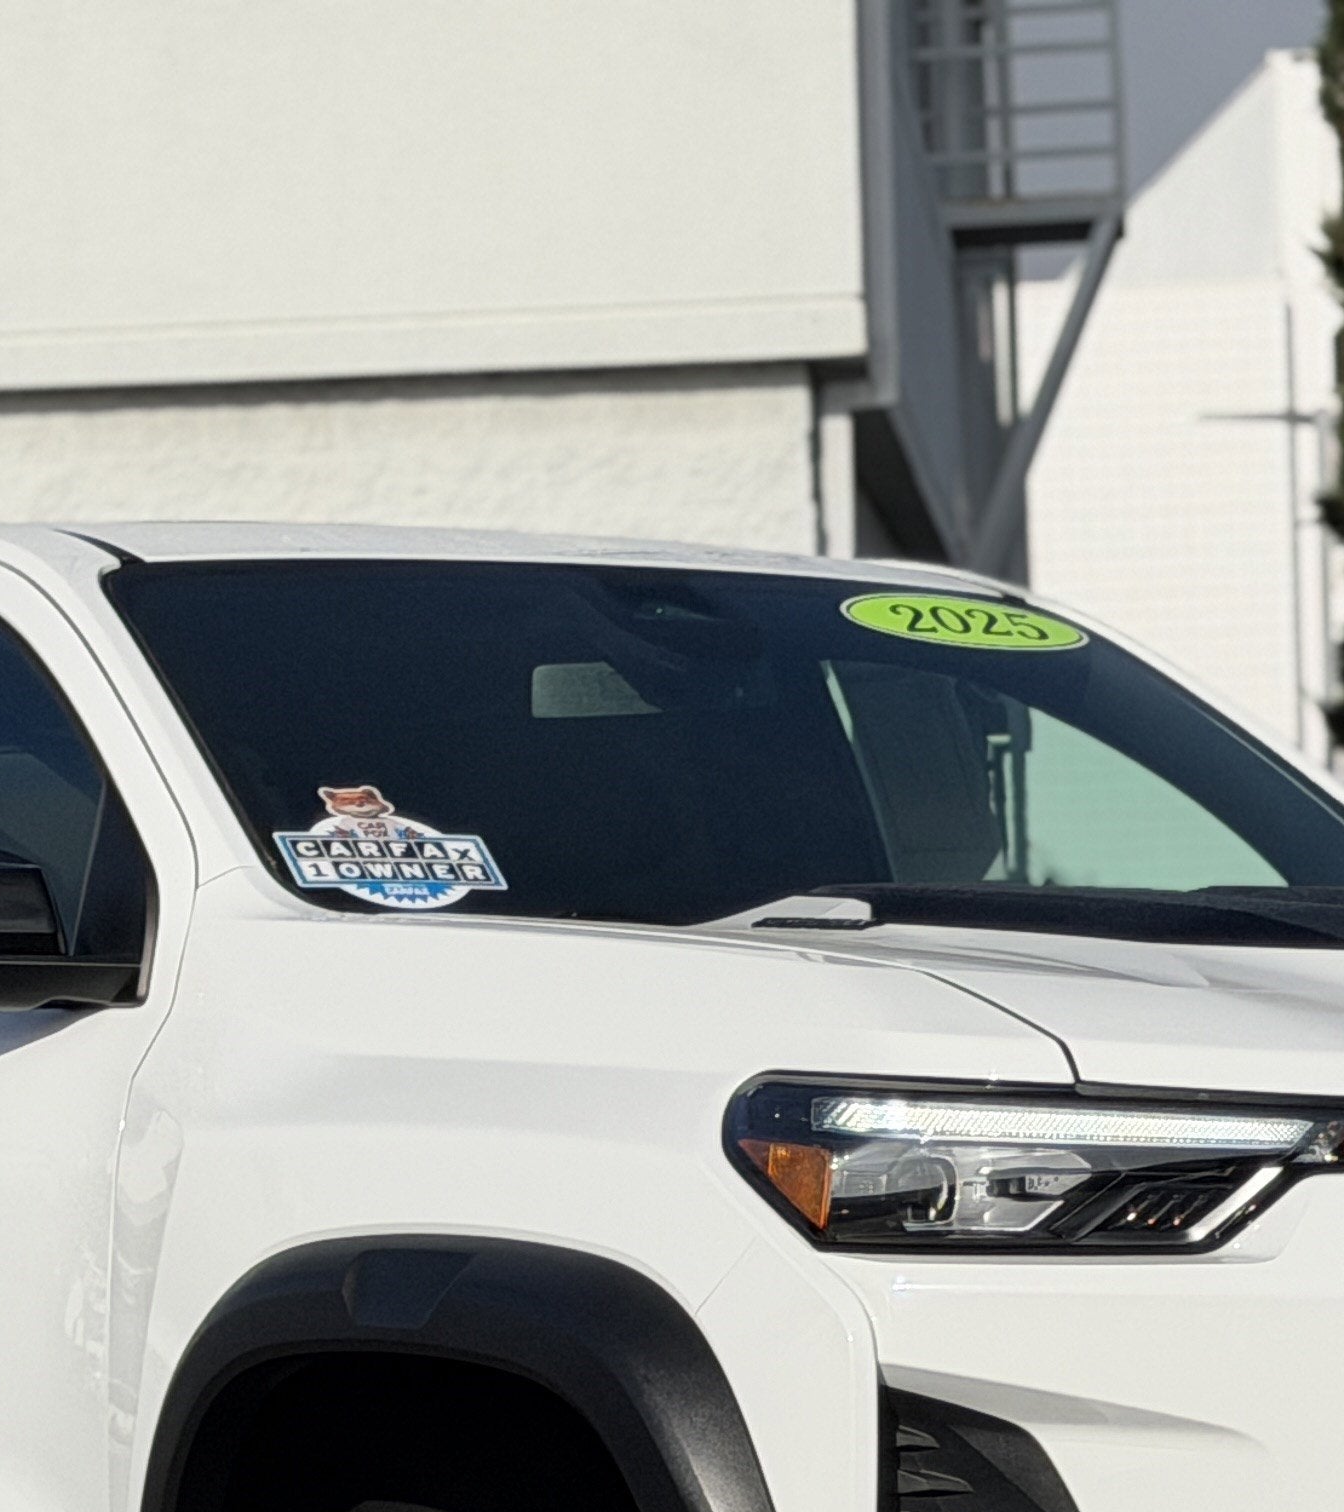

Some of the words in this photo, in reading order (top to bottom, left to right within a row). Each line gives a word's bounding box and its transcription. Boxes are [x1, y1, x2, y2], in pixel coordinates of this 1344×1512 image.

[888, 603, 1050, 642] 2025
[295, 841, 475, 861] CARFAX
[308, 862, 334, 878] 1
[338, 862, 487, 880] OWNER
